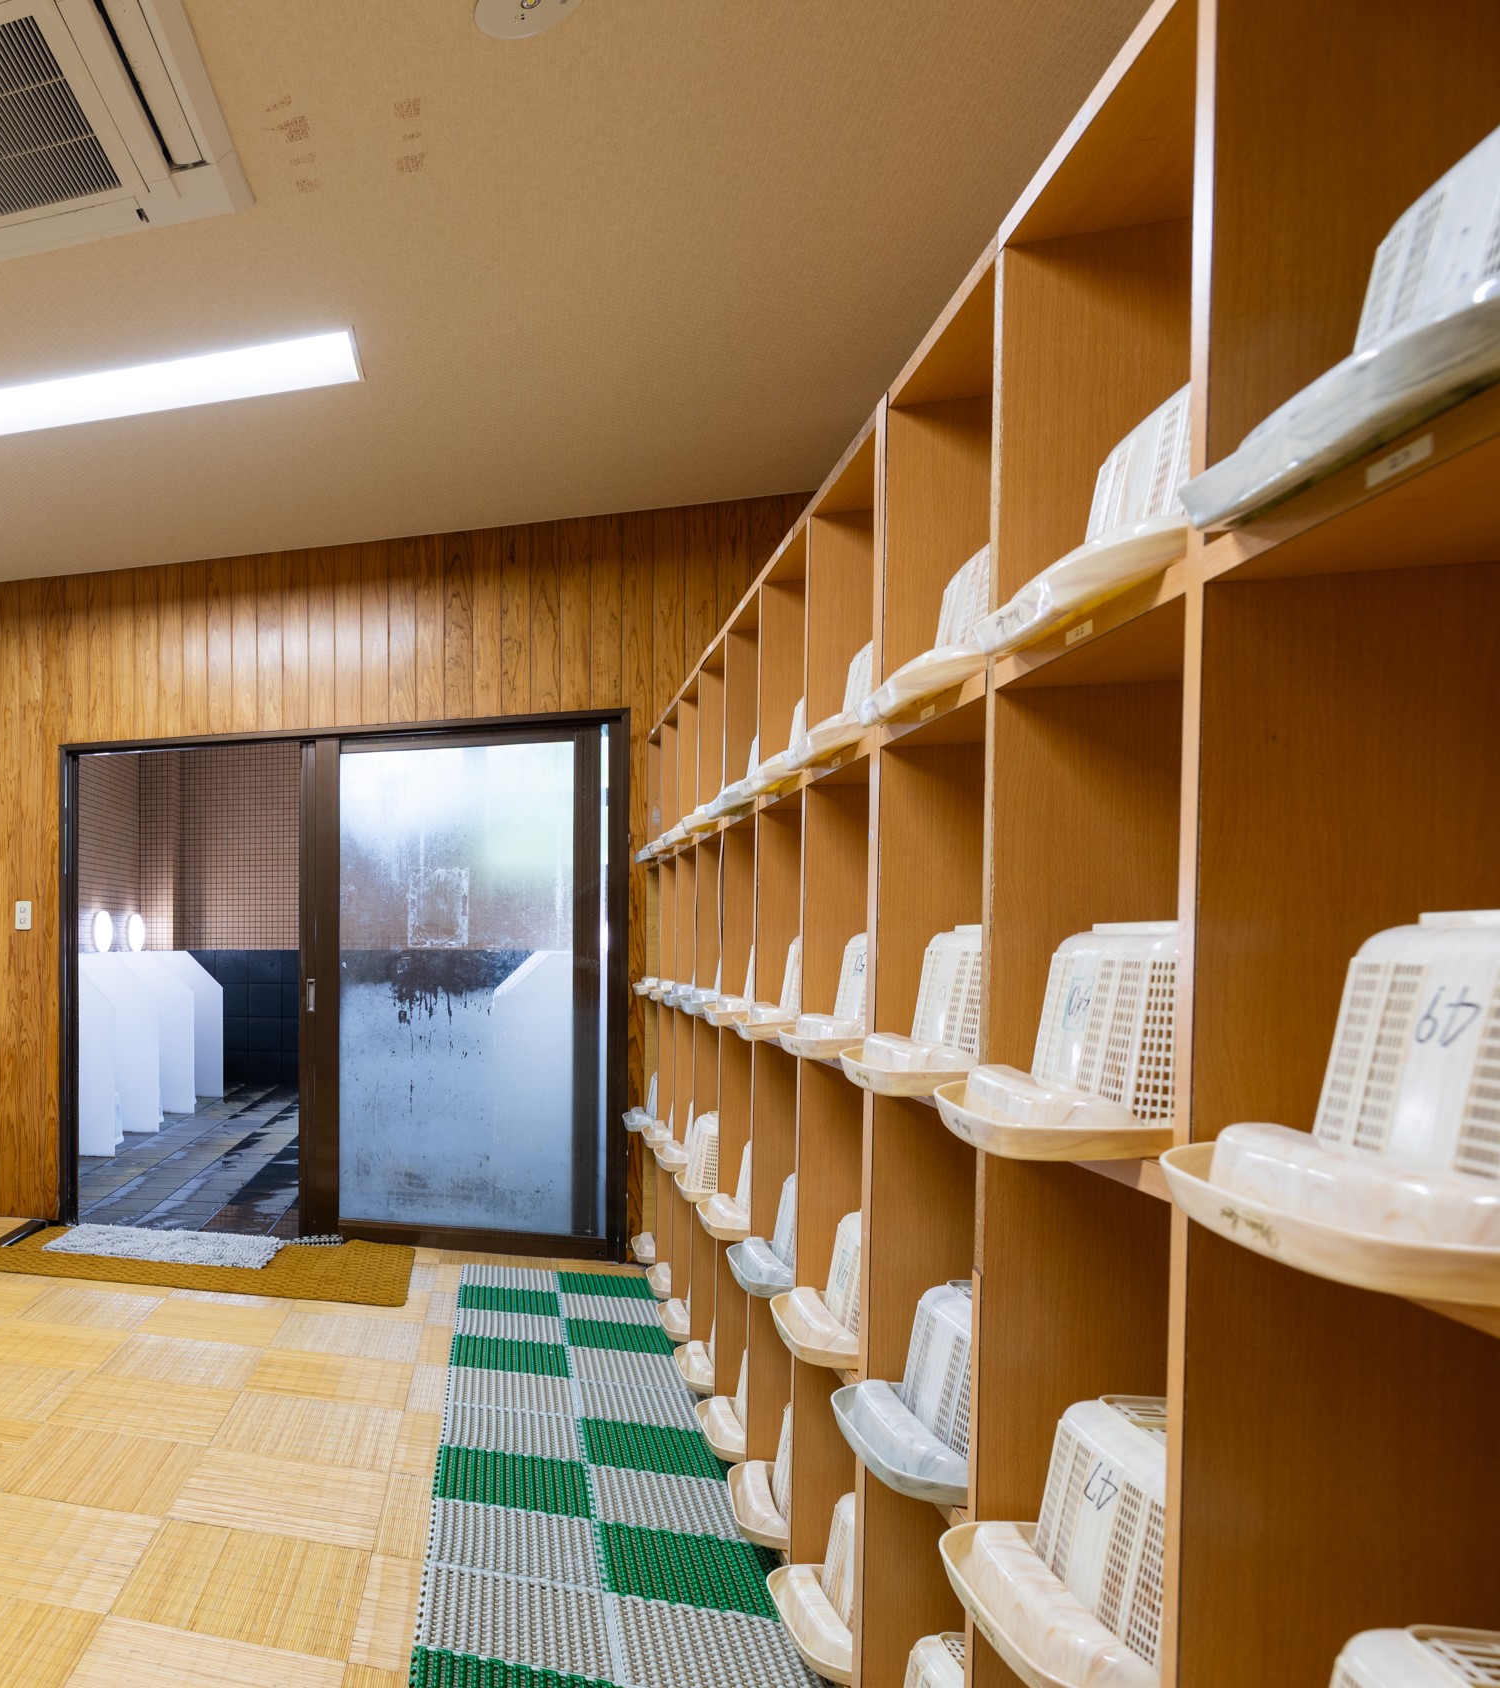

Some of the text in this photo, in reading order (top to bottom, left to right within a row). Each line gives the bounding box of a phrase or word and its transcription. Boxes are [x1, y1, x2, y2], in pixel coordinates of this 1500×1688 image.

[1074, 626, 1085, 637] 22
[1414, 985, 1482, 1048] 49
[1083, 1462, 1119, 1512] 47
